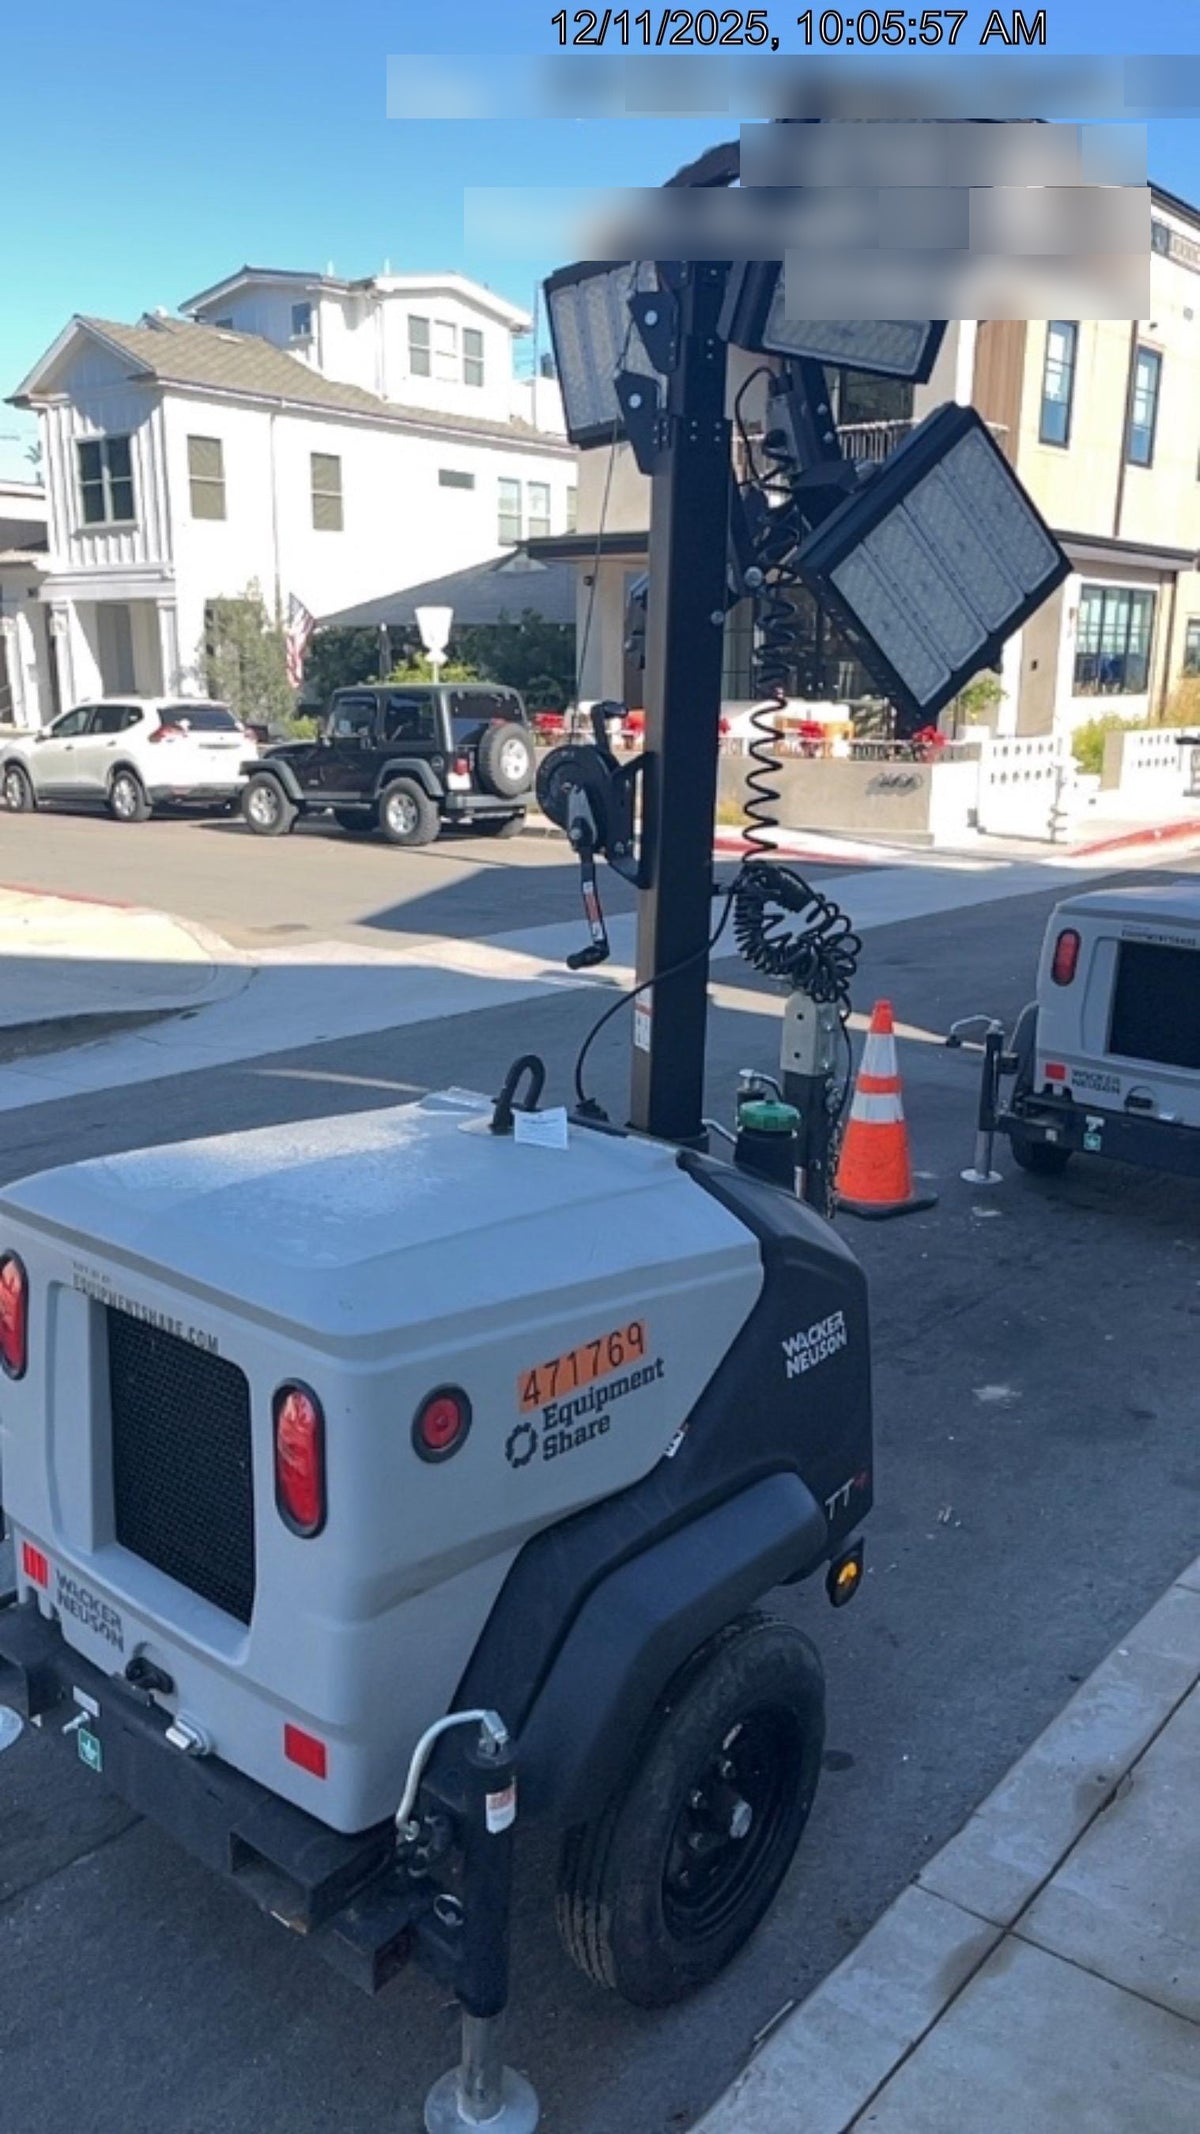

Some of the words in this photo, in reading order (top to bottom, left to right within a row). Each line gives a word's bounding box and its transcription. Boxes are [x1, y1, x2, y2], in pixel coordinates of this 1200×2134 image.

[522, 1321, 644, 1406] 471769
[782, 1310, 845, 1358] WACKER
[786, 1327, 848, 1379] NEUSON
[541, 1356, 665, 1432] Equipment
[542, 1414, 611, 1462] Share
[56, 1567, 121, 1634] WACKER
[57, 1587, 124, 1654] NEUSON
